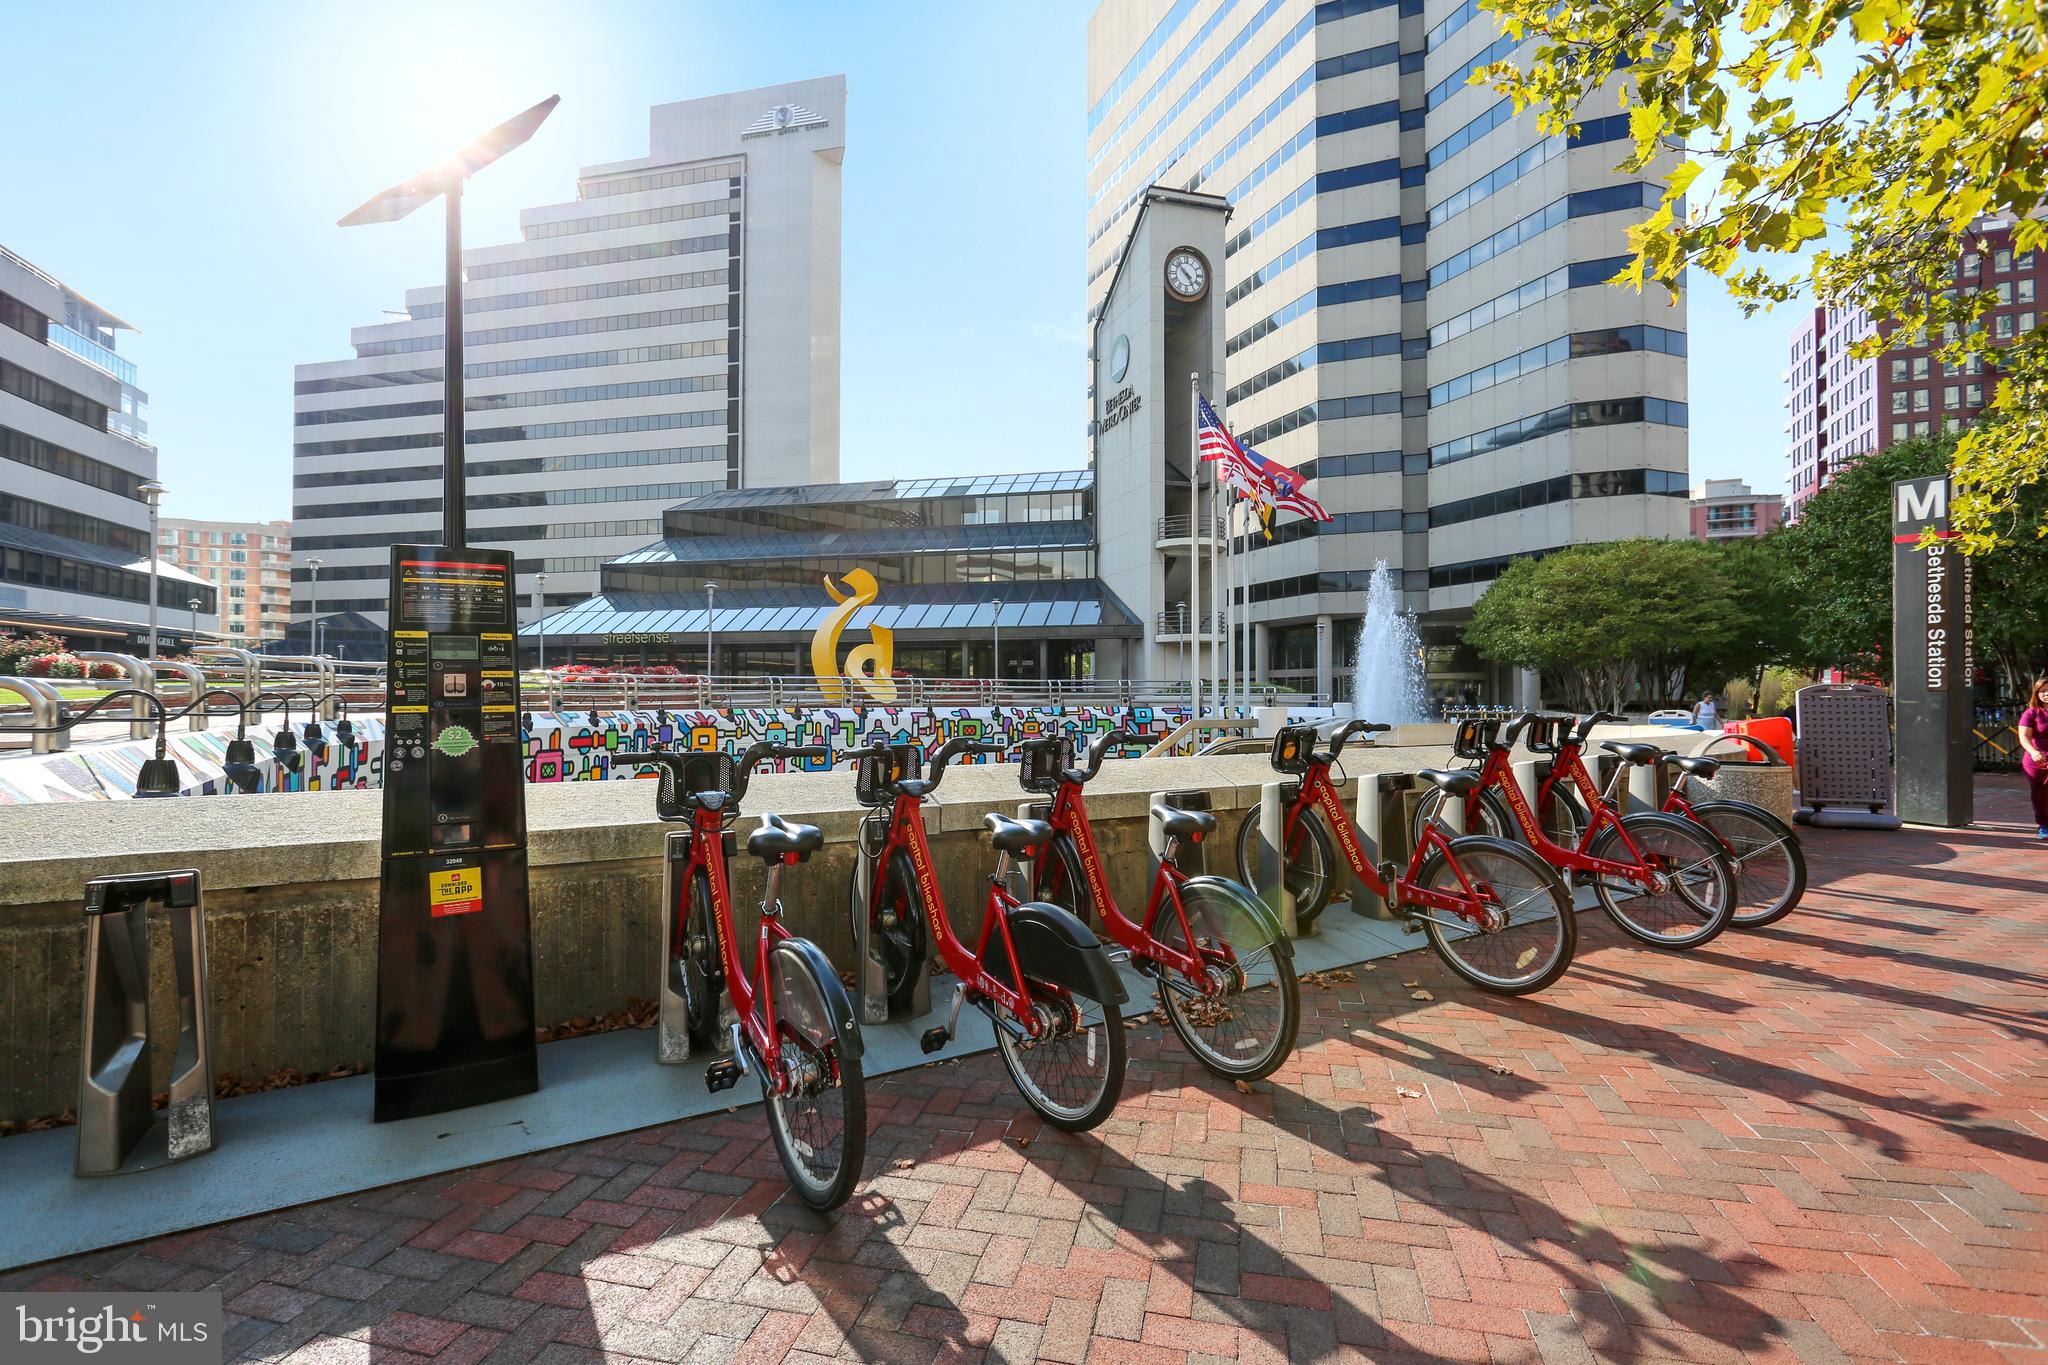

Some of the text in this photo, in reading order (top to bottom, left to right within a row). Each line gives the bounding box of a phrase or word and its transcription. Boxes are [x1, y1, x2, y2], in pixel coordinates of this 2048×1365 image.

[1898, 479, 1946, 523] M
[1927, 546, 1947, 688] Bethesda Station
[1963, 557, 1974, 688] ethesda Station
[1320, 785, 1363, 873] capital bikeshare
[1499, 770, 1539, 846] capital bikeshare
[455, 885, 473, 894] APP
[704, 842, 730, 977] capital bikeshare
[906, 824, 943, 941] capital bikeshare
[1070, 811, 1107, 918] capital bikeshare
